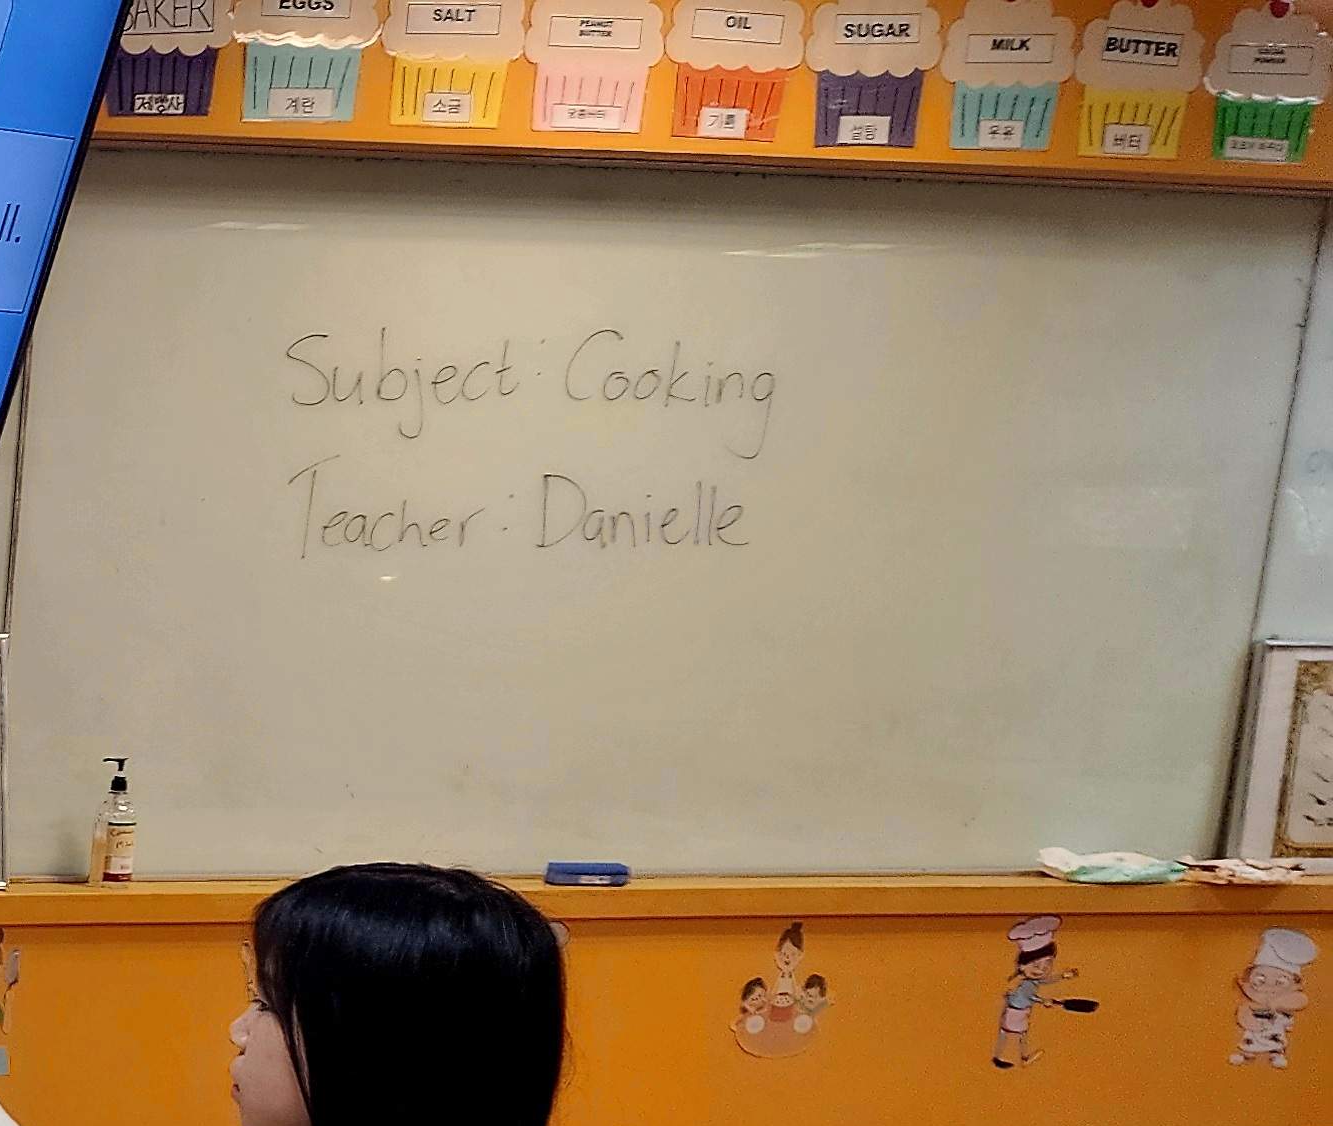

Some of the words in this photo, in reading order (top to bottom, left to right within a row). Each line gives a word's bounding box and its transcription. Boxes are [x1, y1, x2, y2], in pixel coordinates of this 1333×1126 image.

[278, 0, 335, 10] EGGS
[432, 7, 477, 23] SALT
[725, 15, 751, 31] OIL
[843, 21, 911, 39] SUGAR
[990, 37, 1031, 53] MILK
[1105, 37, 1178, 58] BUTTER
[285, 97, 316, 114] 계란
[432, 97, 461, 115] 소금
[850, 124, 878, 141] 설탕
[565, 328, 777, 459] Cooking
[536, 473, 750, 548] Danielle
